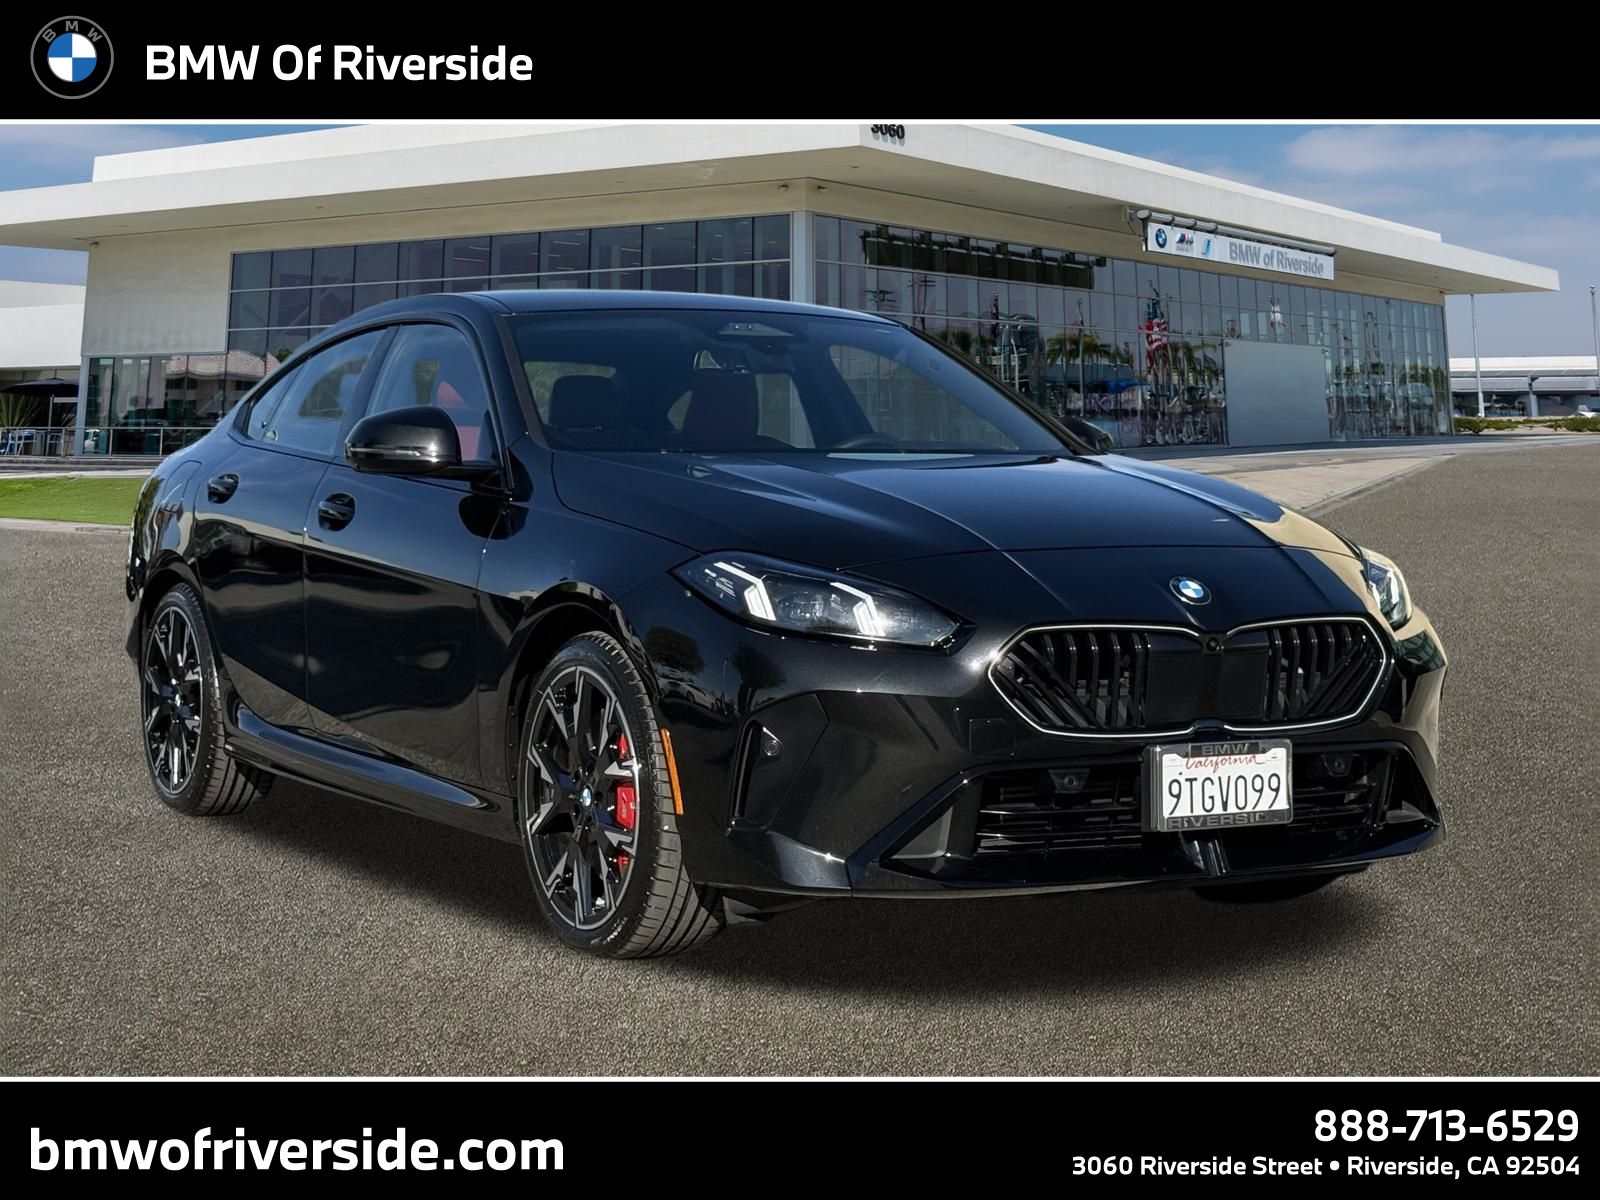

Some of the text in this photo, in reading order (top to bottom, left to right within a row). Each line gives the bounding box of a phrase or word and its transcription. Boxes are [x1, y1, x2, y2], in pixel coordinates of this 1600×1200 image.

[1229, 241, 1324, 275] BMW of Riverside
[1202, 743, 1248, 756] BMW
[1185, 754, 1266, 774] California
[1168, 773, 1281, 815] 9TGV099
